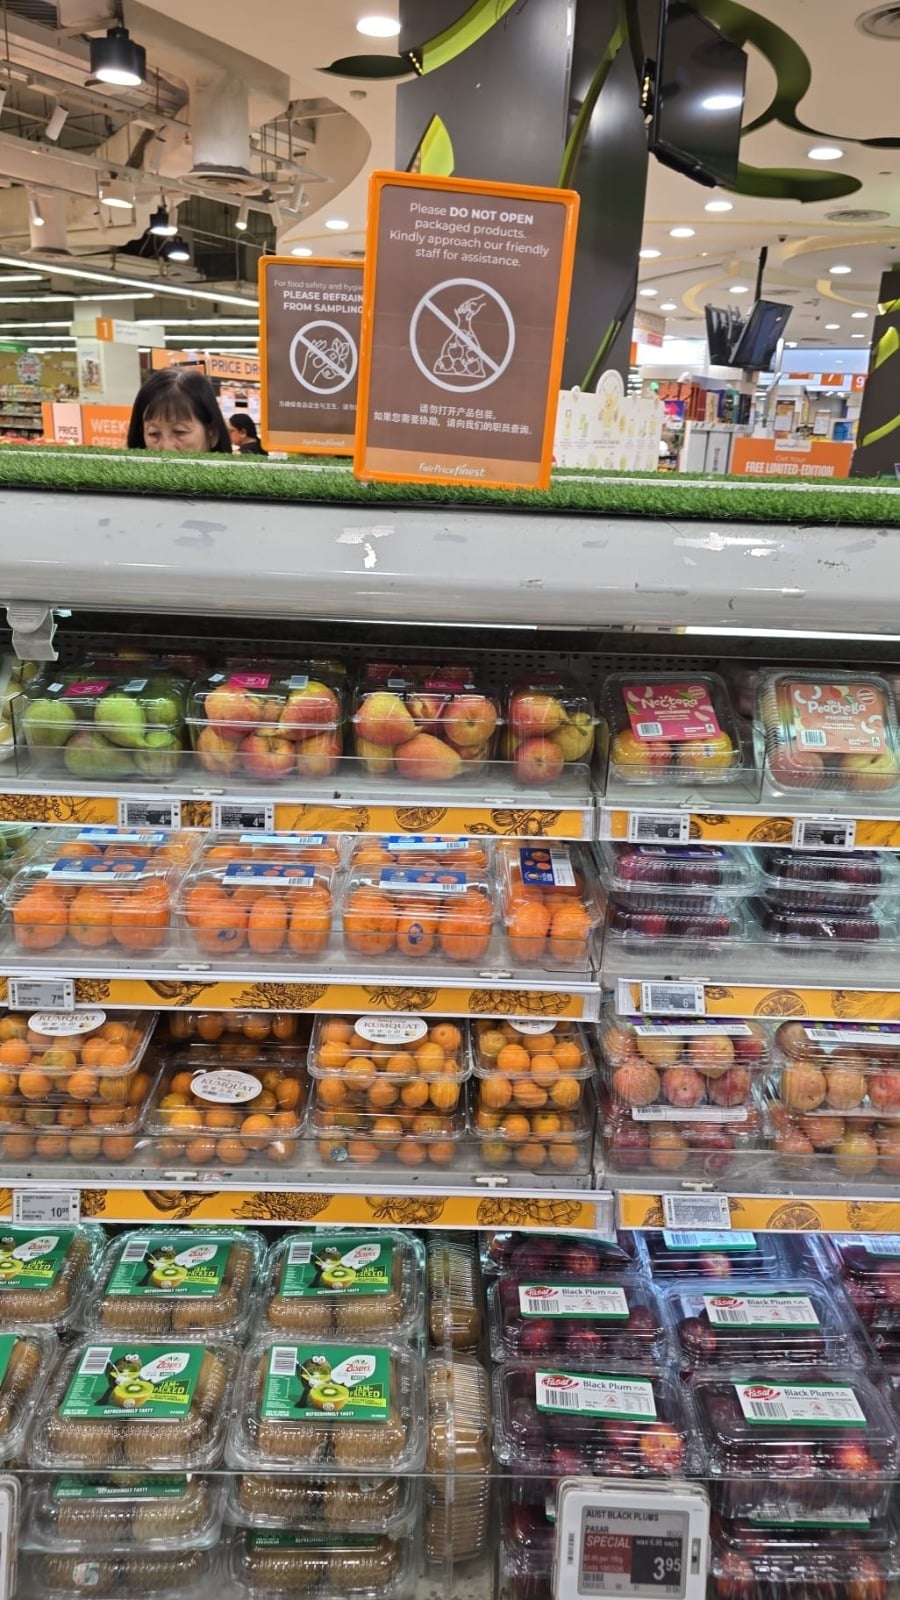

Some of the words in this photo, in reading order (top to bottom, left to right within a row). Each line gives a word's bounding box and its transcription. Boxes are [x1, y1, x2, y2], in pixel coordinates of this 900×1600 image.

[410, 203, 446, 215] Please
[450, 206, 468, 218] DO
[471, 209, 497, 220] NOT
[499, 212, 533, 224] OPEN
[415, 220, 470, 233] packaged
[474, 223, 526, 239] products.
[390, 230, 426, 244] Kindly
[428, 234, 480, 249] approach
[484, 240, 504, 250] our
[506, 241, 550, 257] friendly
[415, 248, 441, 258] staff
[443, 250, 458, 260] for
[461, 252, 521, 267] assistance.
[283, 290, 320, 300] PLEASE
[283, 302, 312, 311] FROM
[101, 322, 109, 339] 1
[211, 359, 241, 374] PRICE
[856, 376, 865, 388] 9
[58, 426, 78, 436] PRICE
[746, 462, 765, 473] FREE
[583, 1380, 606, 1388] Black
[609, 1382, 632, 1390] Plum
[586, 1510, 605, 1518] AUST
[608, 1511, 631, 1520] BLACK
[634, 1513, 659, 1522] PLUMS
[586, 1536, 631, 1548] SPECIAL
